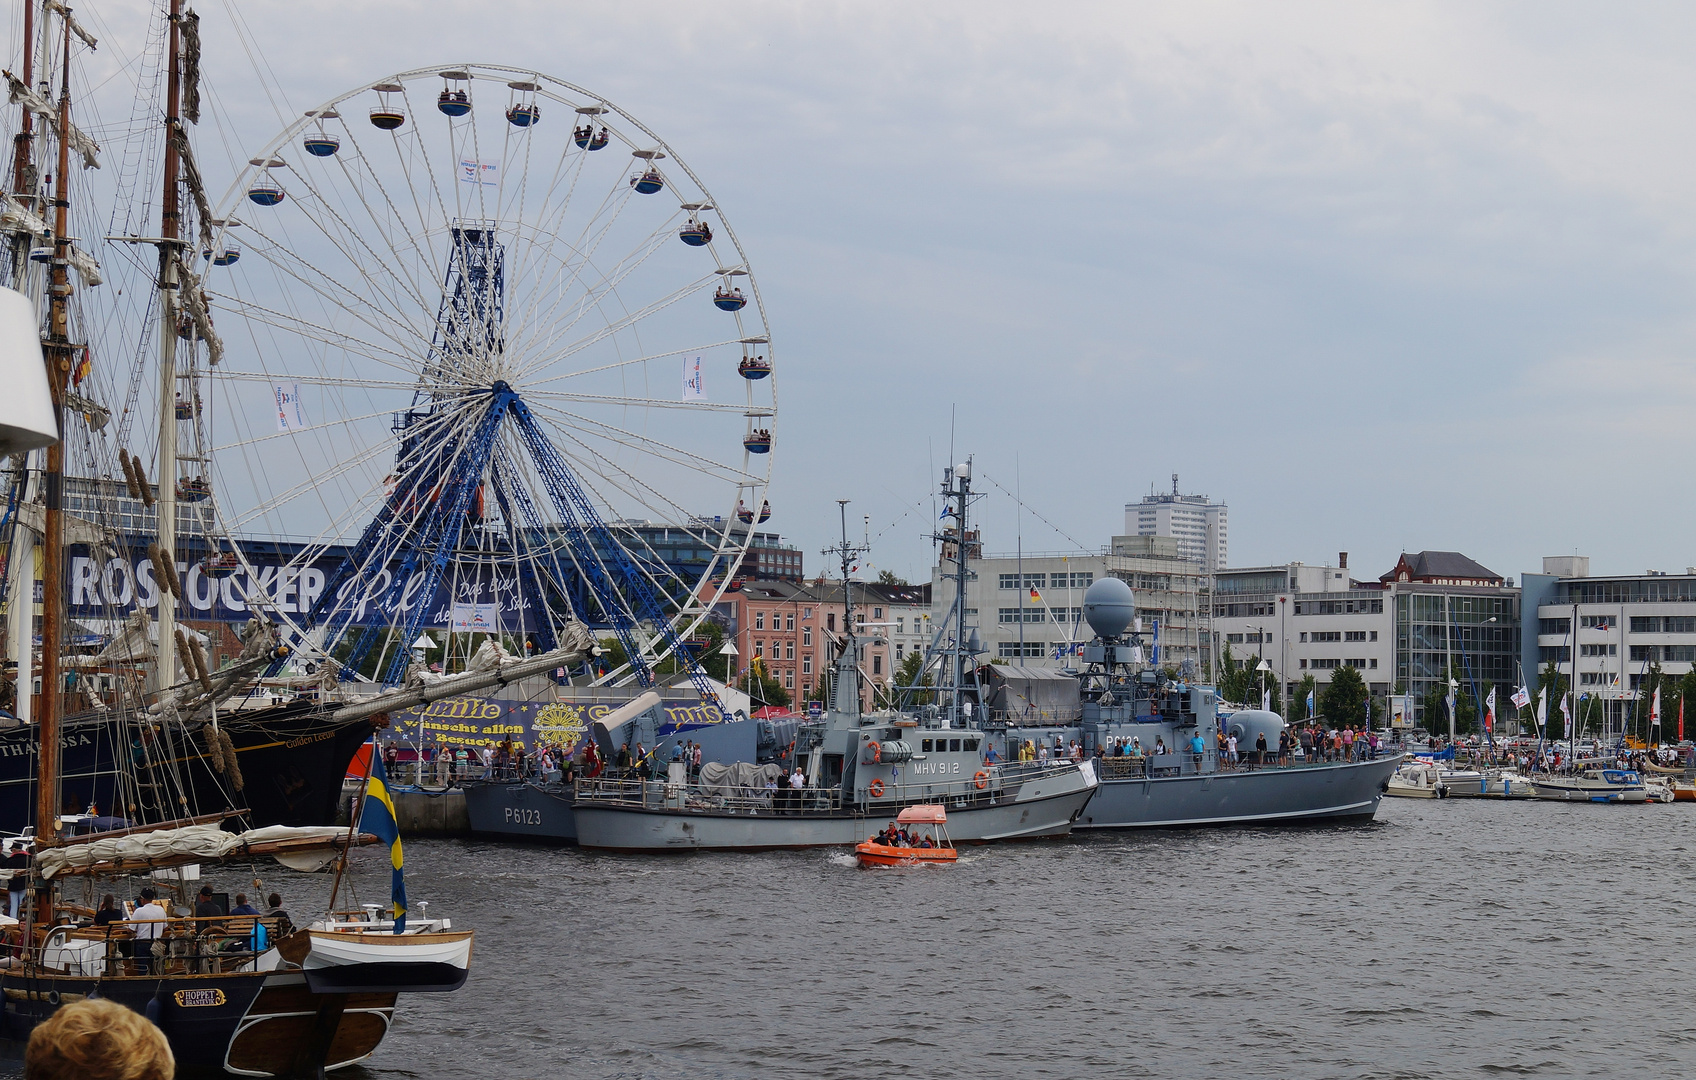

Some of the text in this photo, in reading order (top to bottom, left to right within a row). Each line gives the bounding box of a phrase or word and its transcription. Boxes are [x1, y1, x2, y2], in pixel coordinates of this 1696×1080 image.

[482, 724, 524, 735] allen
[914, 762, 960, 774] MHV 912
[504, 807, 541, 825] P6123
[185, 991, 215, 1000] HOPPET
